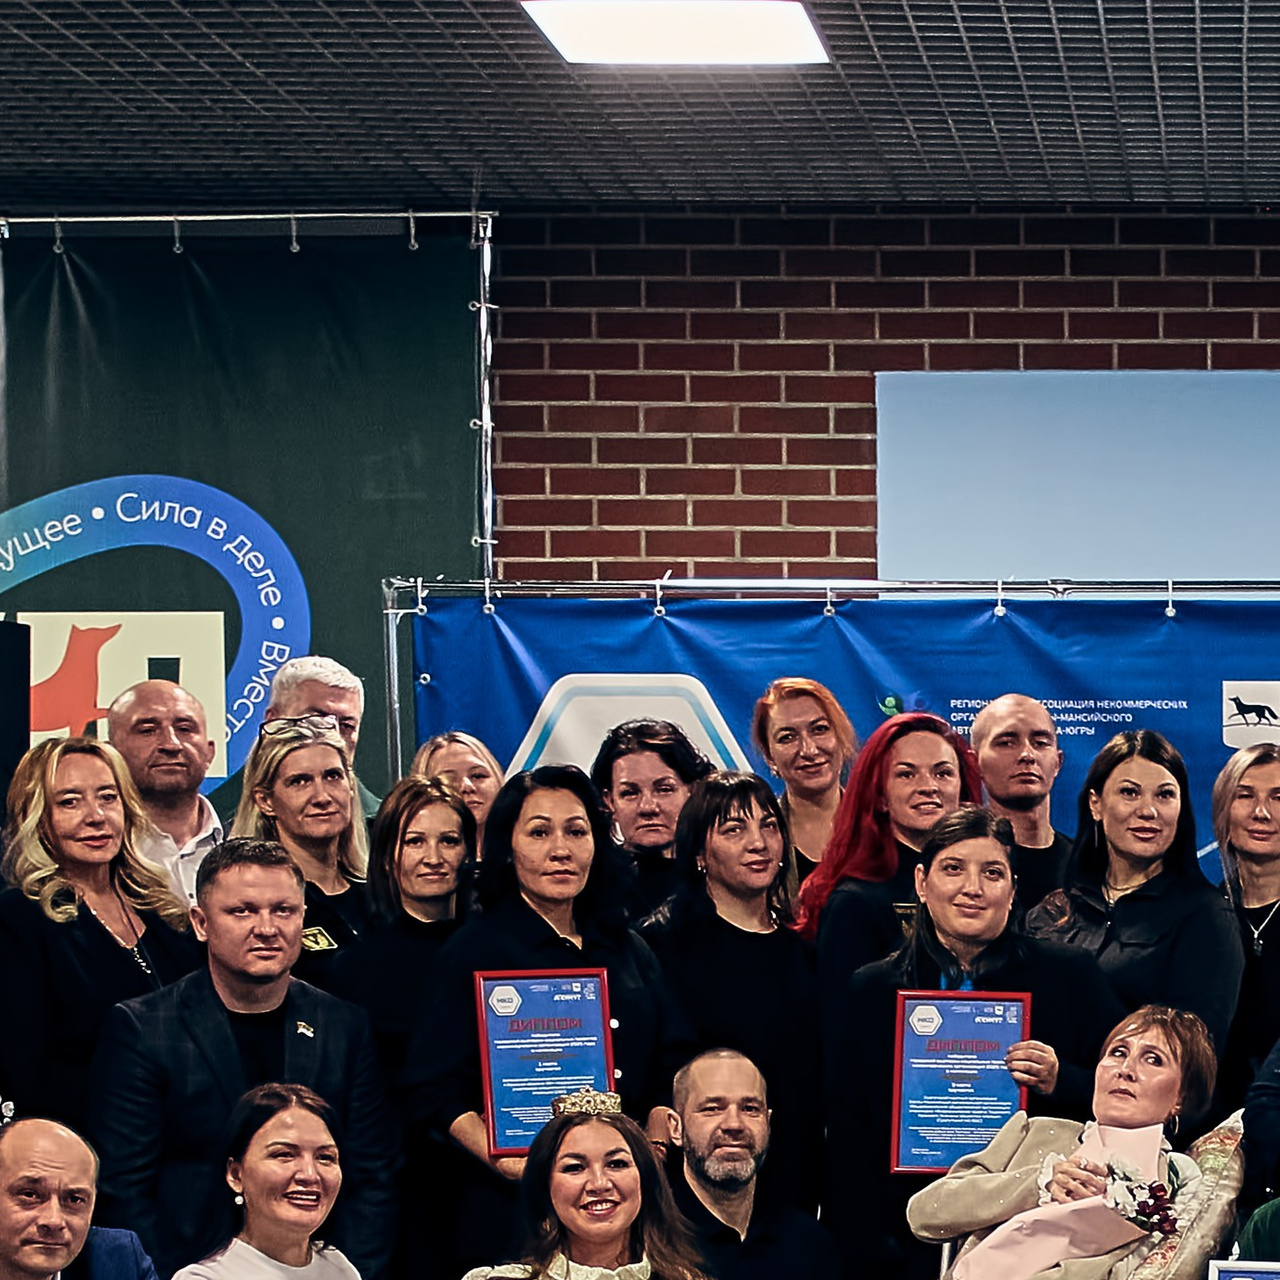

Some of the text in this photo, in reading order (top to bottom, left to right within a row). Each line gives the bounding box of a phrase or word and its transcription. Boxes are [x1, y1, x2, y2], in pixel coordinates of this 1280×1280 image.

[0, 513, 83, 571] ущее
[116, 493, 282, 607] Сила в деле
[226, 640, 291, 743] Вмест
[1043, 699, 1095, 709] СОЦИАЦИЯ
[1097, 700, 1188, 709] НЕКОММЕРЧЕСКИХ
[1056, 726, 1095, 735] А-ЮГРЫ
